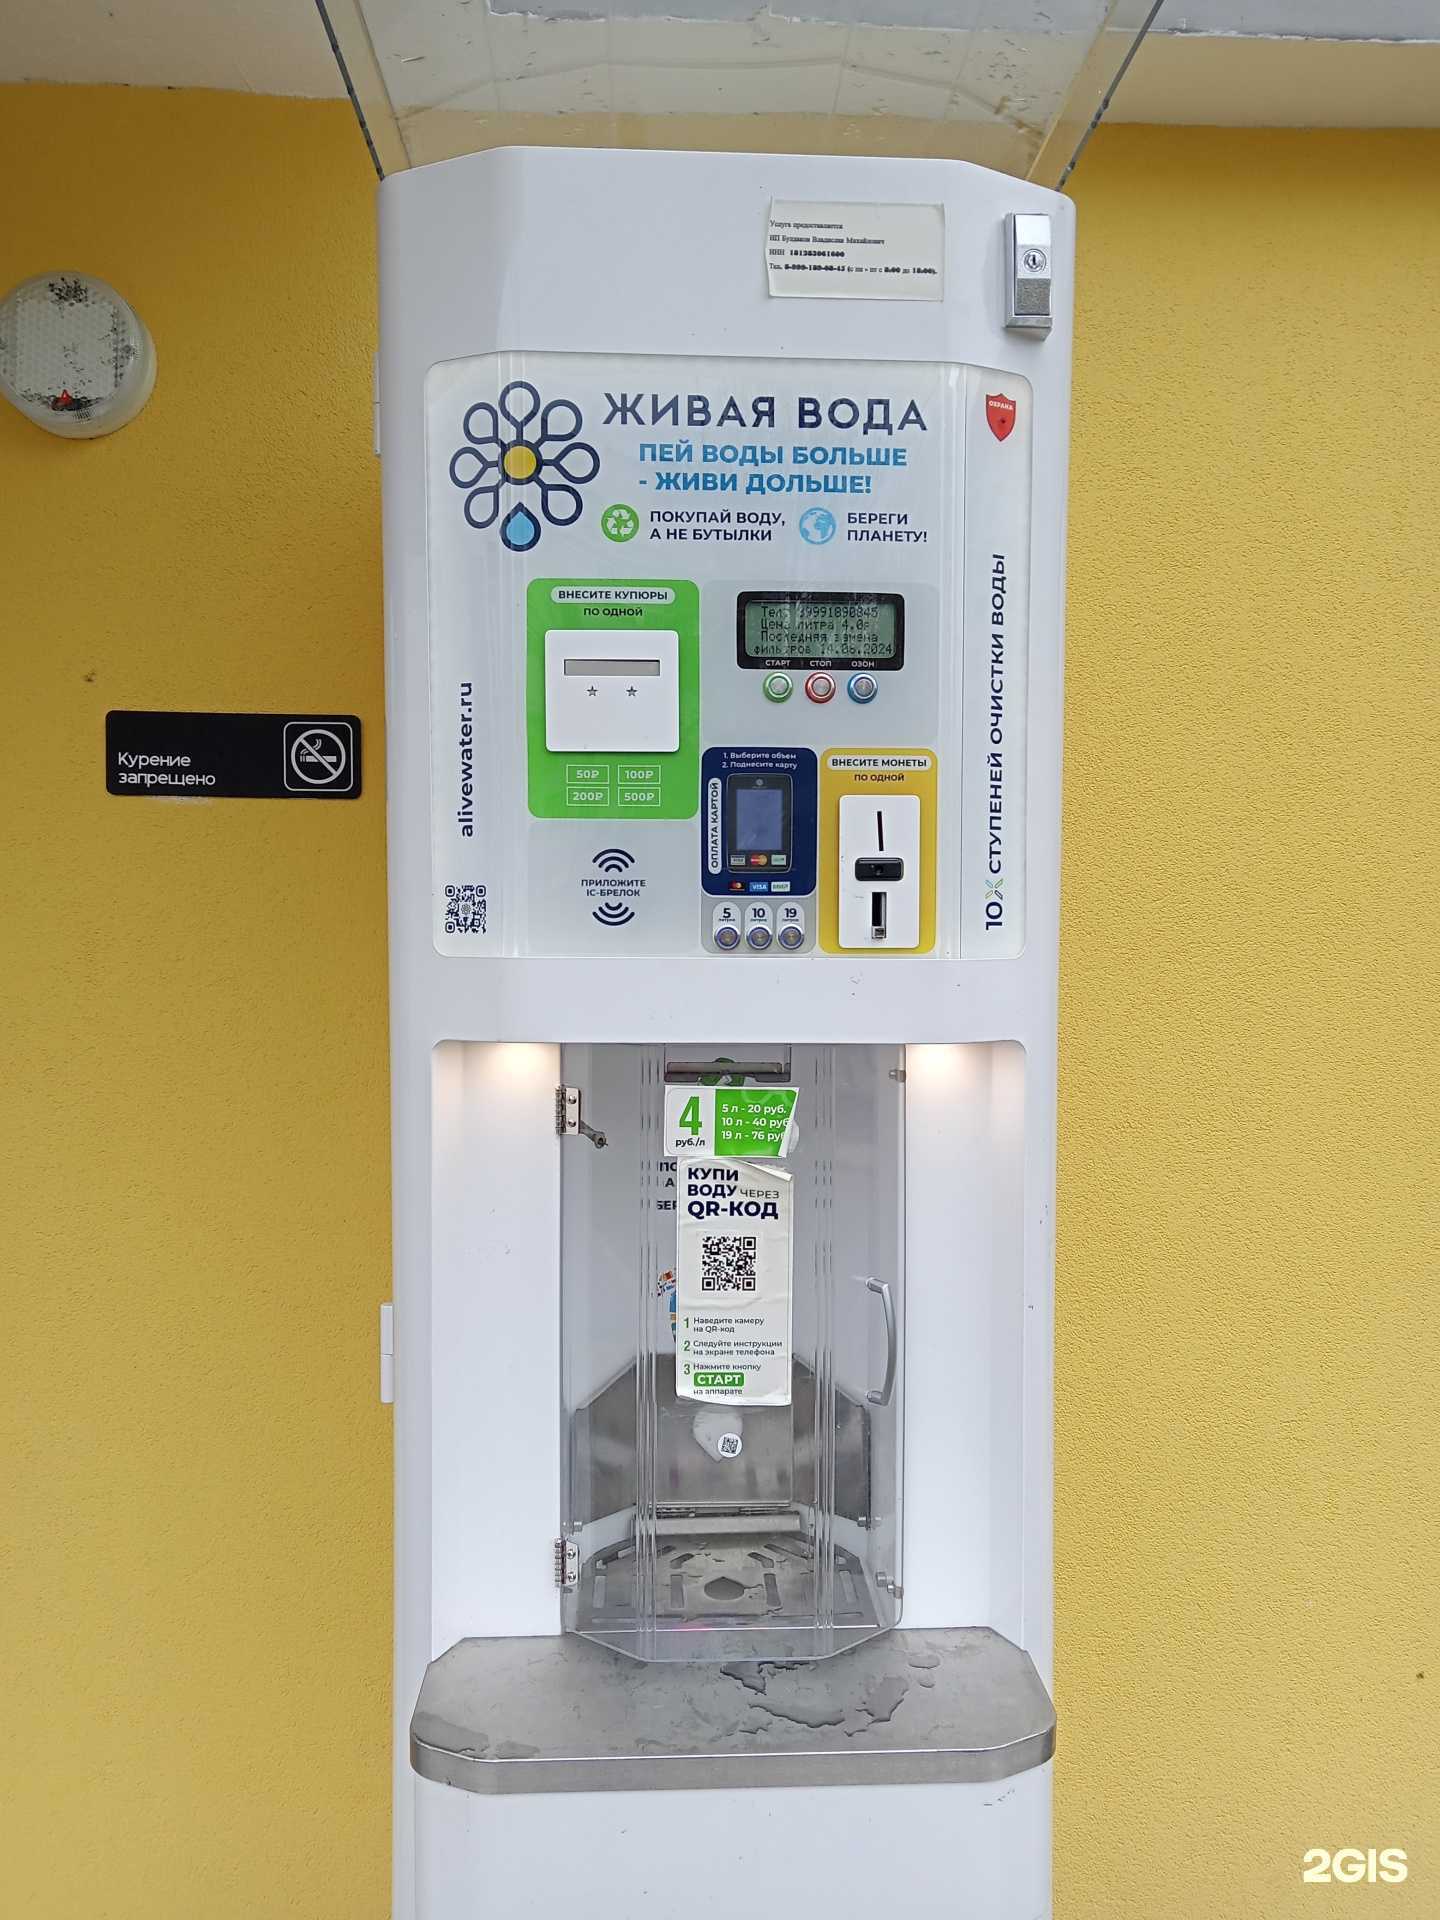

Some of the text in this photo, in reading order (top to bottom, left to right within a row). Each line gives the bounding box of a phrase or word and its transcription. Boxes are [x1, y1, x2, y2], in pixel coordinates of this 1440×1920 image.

[602, 392, 928, 436] ЖИВАЯ ВОДА
[639, 438, 908, 467] ПЕЙ ВОДЫ БОЛЬШЕ
[655, 471, 738, 492] ЖИВИ
[745, 473, 872, 495] ДОЛЬШЕ!
[650, 508, 785, 527] ПОКУПАЙ ВОДУ,
[847, 512, 908, 525] БЕРЕГИ
[649, 528, 772, 542] А НЕ БУТЫЛКИ
[847, 529, 928, 543] ПЛАНЕТУ!
[558, 589, 668, 601] ВНЕСИТЕ КУПЮРЫ
[583, 606, 643, 617] ПО ОДНОЙ
[760, 630, 828, 643] Последняя
[765, 659, 791, 668] СТАРТ
[809, 659, 832, 668] СТОП
[851, 660, 875, 669] ОЗОН
[985, 553, 1007, 931] 10 СТУПЕНЕЙ ОЧИСТКИ ВОДЫ
[117, 751, 191, 770] Курение
[457, 682, 474, 838] alivewater.ru
[723, 751, 797, 760] 1. Выберите объем
[721, 761, 798, 771] 2. Поднесите карту
[831, 758, 928, 768] ВНЕСИТЕ МОНЕТЫ
[118, 771, 216, 788] запрещено
[854, 773, 905, 783] ПО ОДНОЙ
[709, 782, 719, 869] ОПЛАТА КАРТОЙ
[580, 878, 647, 888] ПРИЛОЖИТЕ
[752, 883, 767, 891] VISA
[586, 888, 641, 897] IC-БРЕЛОК
[722, 907, 732, 919] 5
[751, 907, 766, 919] 10
[784, 907, 798, 919] 19
[721, 1103, 729, 1113] 5
[731, 1105, 739, 1113] л
[747, 1104, 761, 1113] 20
[763, 1103, 787, 1114] руб.
[679, 1095, 703, 1136] 4
[721, 1117, 733, 1127] 10
[735, 1119, 743, 1127] л
[752, 1117, 767, 1127] 40
[721, 1130, 733, 1140] 19
[734, 1132, 742, 1140] л
[751, 1131, 765, 1140] 76
[675, 1137, 706, 1148] руб./л
[687, 1167, 739, 1182] КУПИ
[664, 1177, 675, 1188] А
[687, 1184, 780, 1199] ВОДУ ЧЕРЕЗ
[687, 1200, 779, 1220] QR-КОД
[683, 1316, 689, 1329] 1
[693, 1316, 765, 1326] Наведите камеру
[705, 1325, 735, 1334] QR-код
[683, 1340, 691, 1352] 2
[693, 1340, 783, 1349] Следуйте инструкции
[705, 1349, 734, 1357] экране
[735, 1349, 775, 1357] телефона
[683, 1363, 691, 1376] 3
[693, 1363, 762, 1372] Нажмите кнопку
[696, 1374, 741, 1386] СТАРТ
[704, 1388, 743, 1396] аппарате
